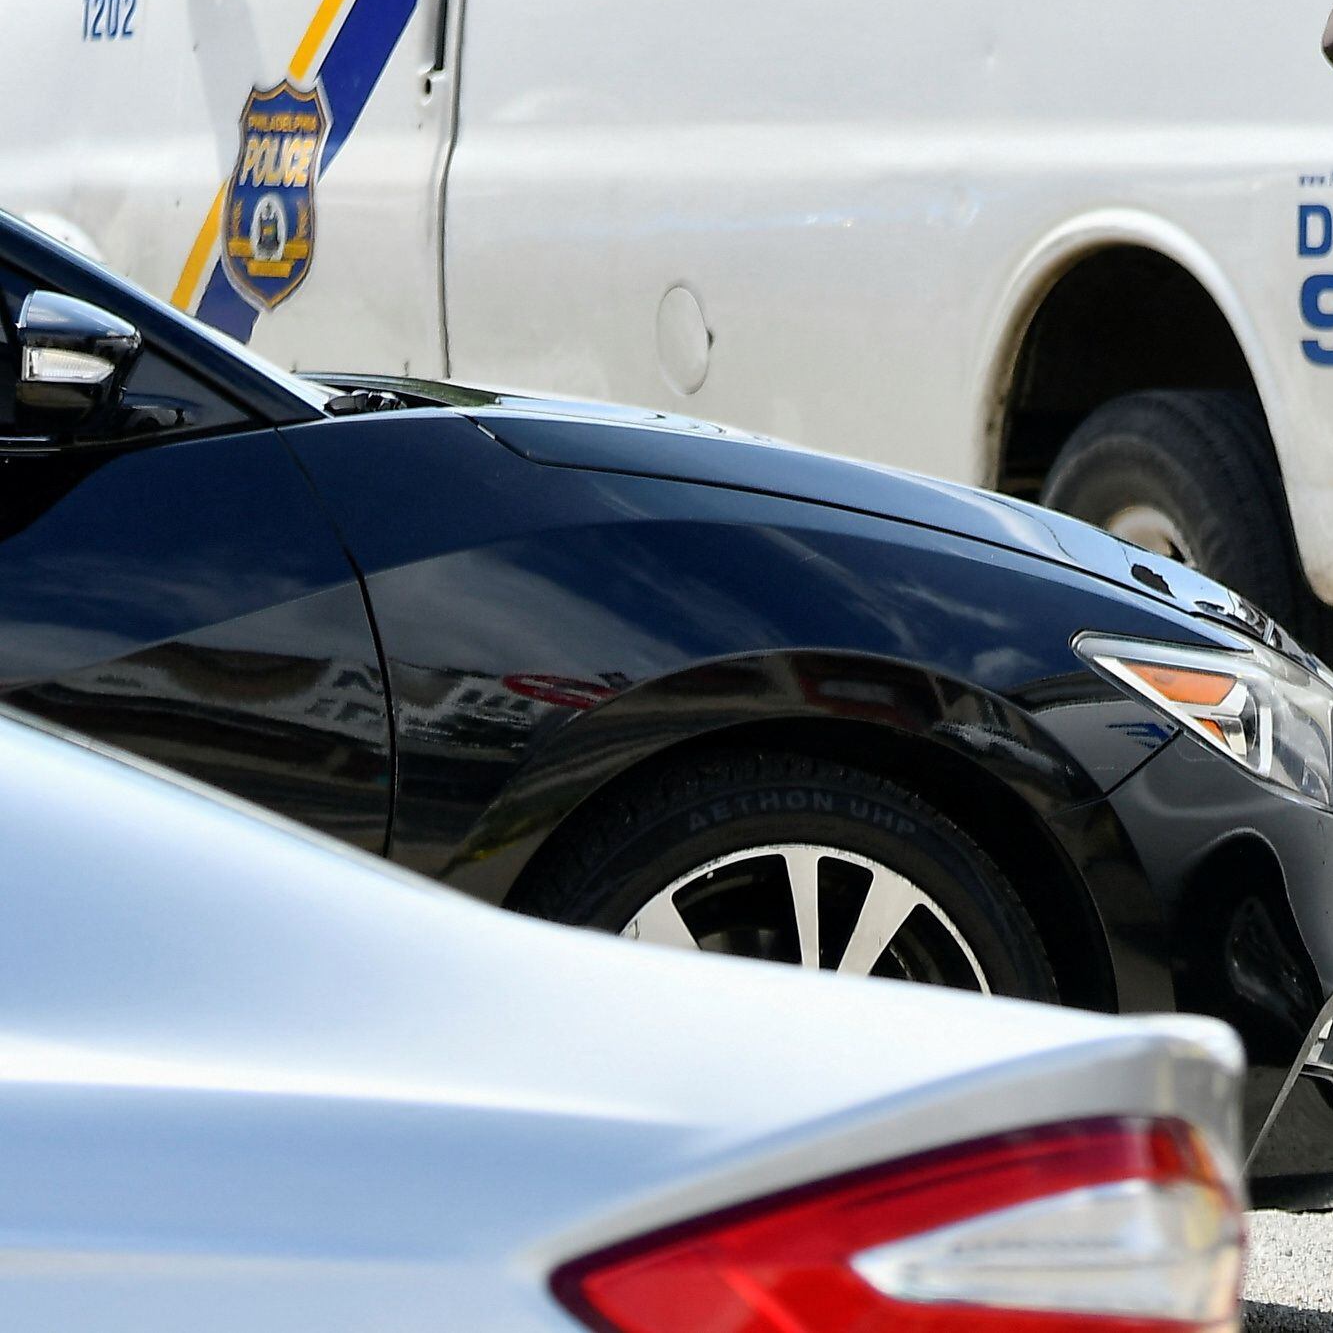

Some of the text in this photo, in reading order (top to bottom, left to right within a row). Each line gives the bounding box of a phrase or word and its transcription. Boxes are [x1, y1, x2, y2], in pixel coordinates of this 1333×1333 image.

[239, 134, 316, 187] POLICE
[687, 788, 918, 836] AETHON UHP
